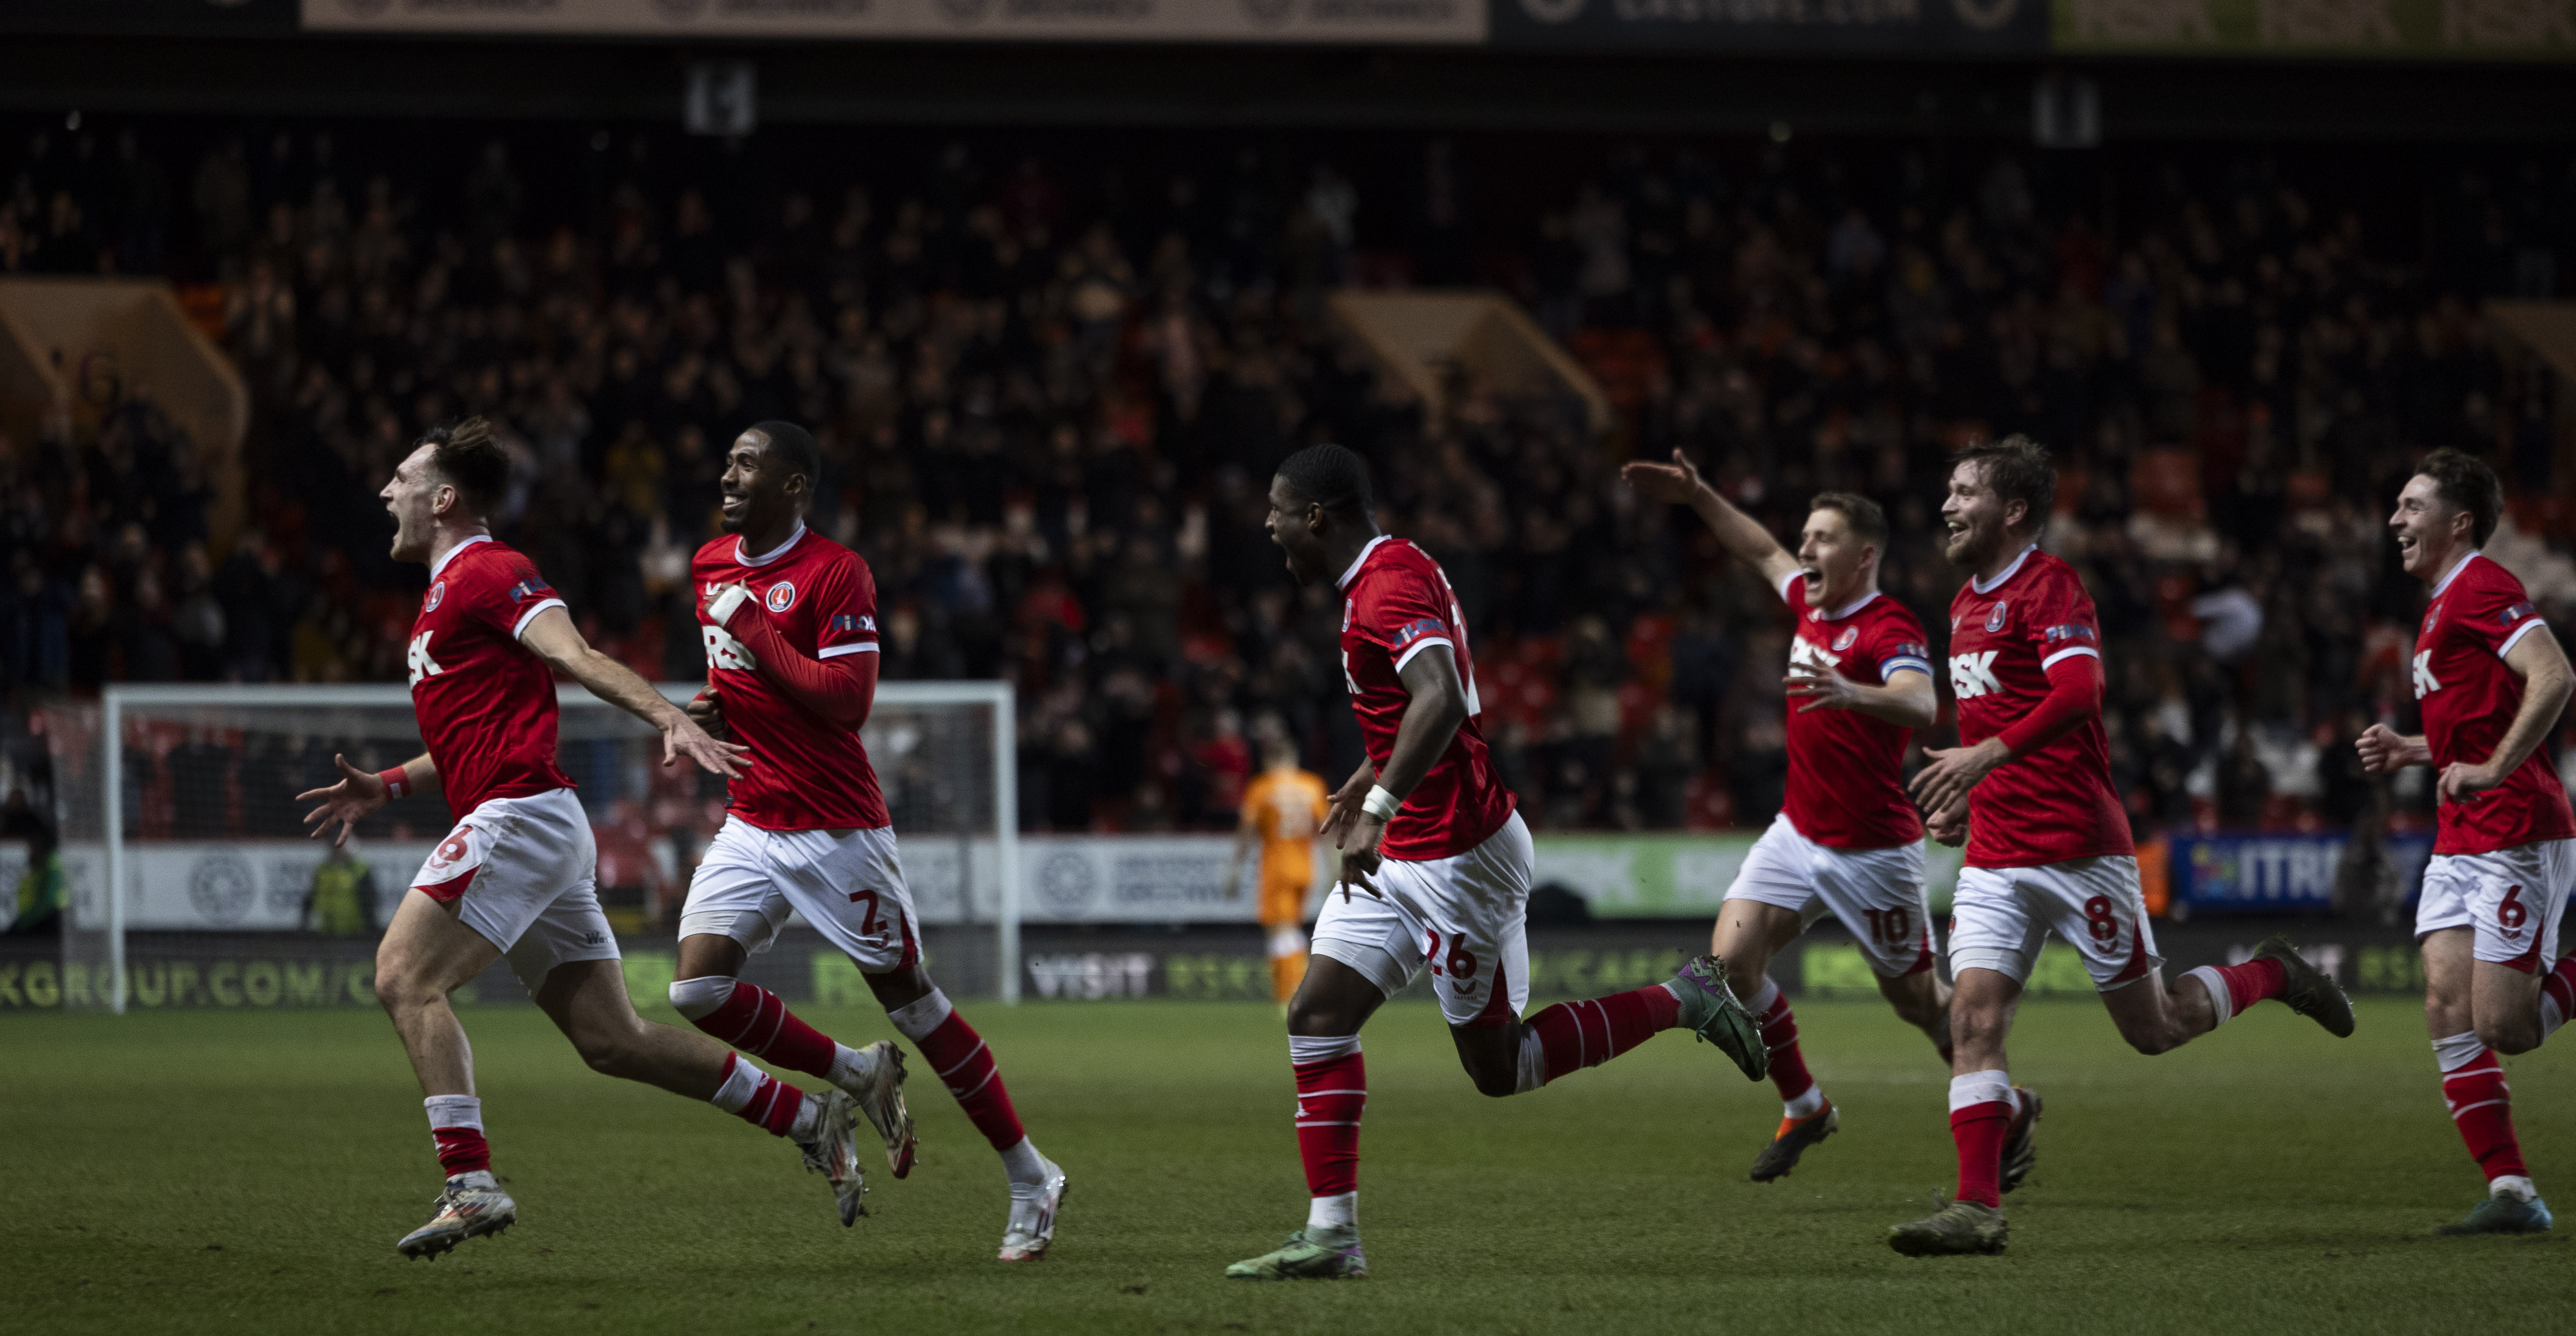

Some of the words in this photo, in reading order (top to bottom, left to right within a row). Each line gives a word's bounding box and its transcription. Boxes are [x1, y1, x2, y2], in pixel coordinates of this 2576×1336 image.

[1949, 650, 2007, 700] SK
[438, 825, 473, 861] 6
[849, 889, 888, 936] 2
[1863, 906, 1910, 945] 10
[2084, 895, 2118, 941] 8
[2498, 885, 2527, 928] 6
[1426, 927, 1477, 980] 26
